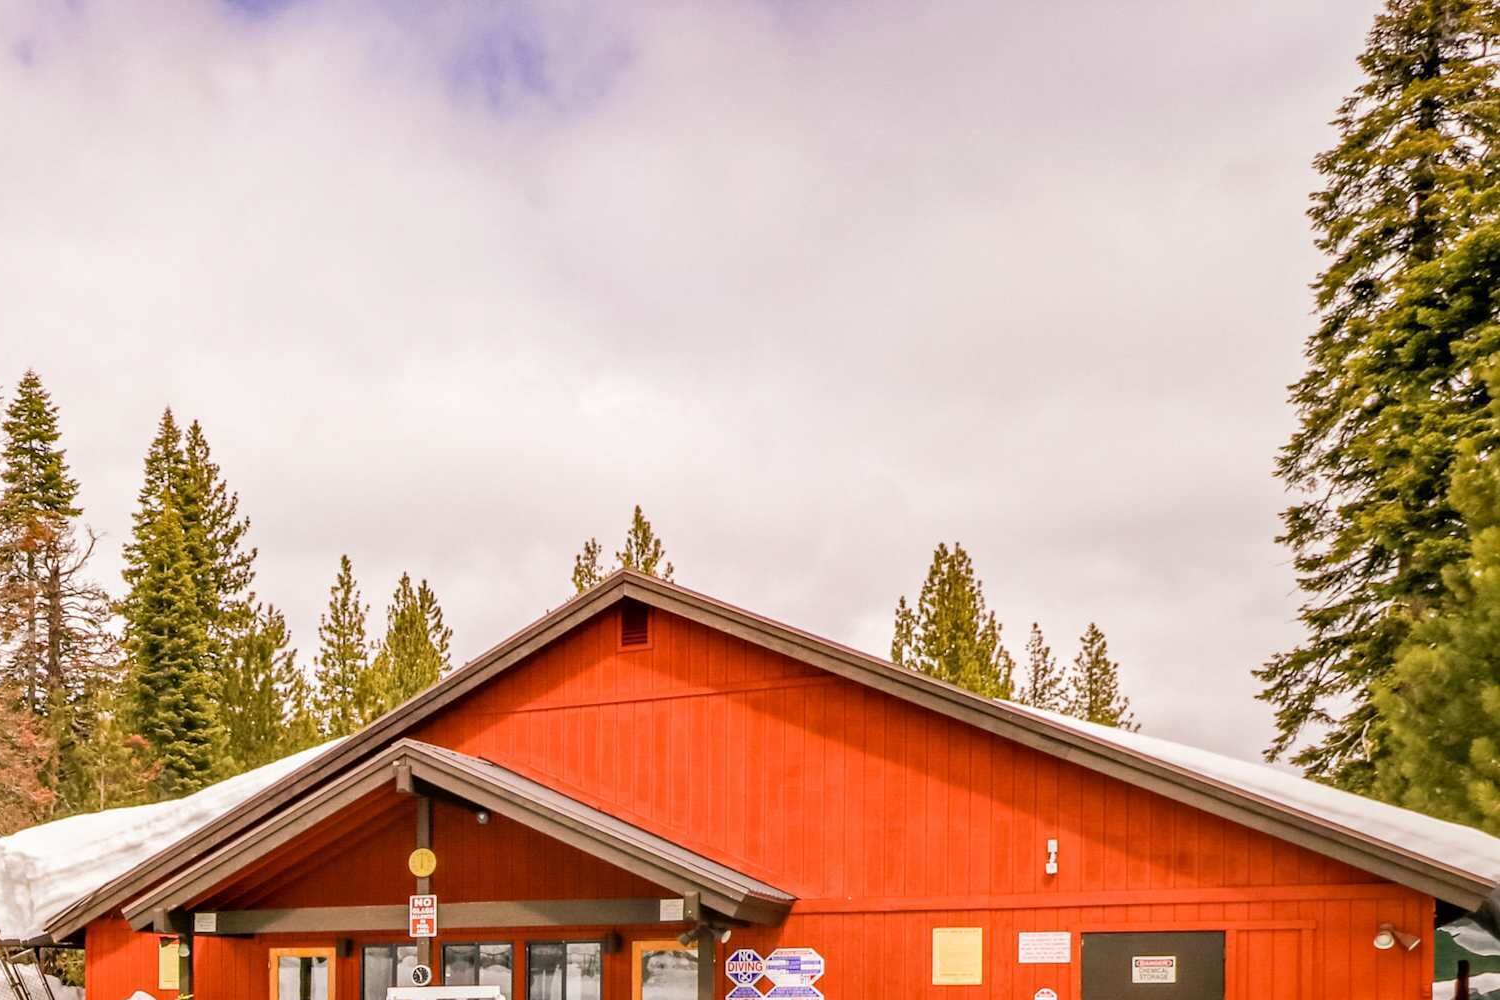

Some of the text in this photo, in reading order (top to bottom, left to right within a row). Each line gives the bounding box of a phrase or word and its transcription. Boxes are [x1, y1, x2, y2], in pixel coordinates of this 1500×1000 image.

[414, 898, 432, 907] NO
[739, 952, 752, 961] NO
[728, 962, 763, 972] DIVING
